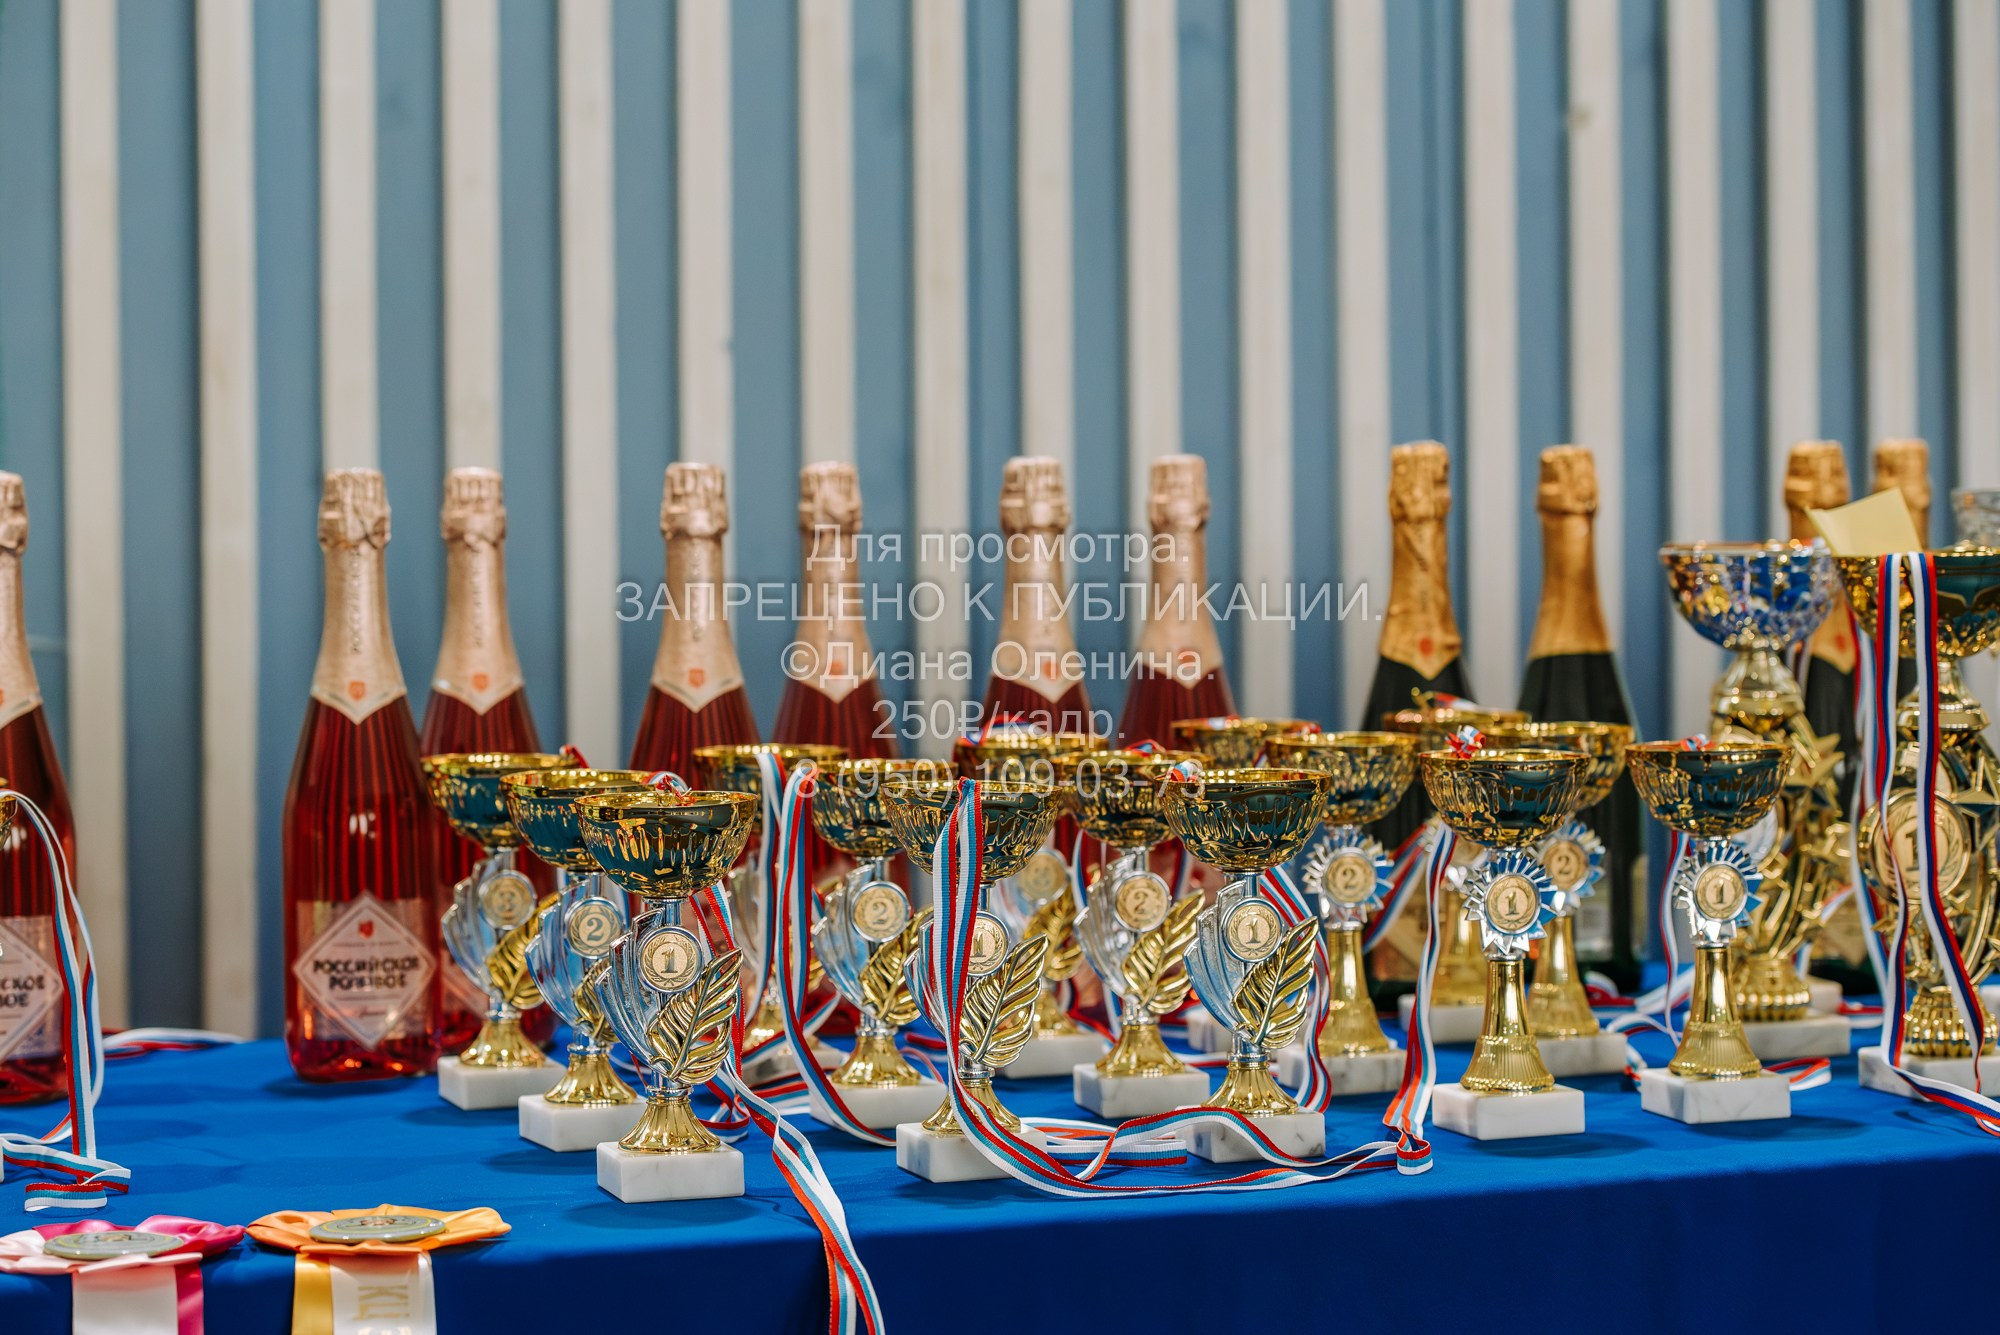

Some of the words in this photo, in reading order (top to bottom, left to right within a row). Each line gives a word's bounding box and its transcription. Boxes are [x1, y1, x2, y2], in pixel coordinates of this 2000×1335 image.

[1905, 829, 1919, 872] 1
[1342, 867, 1358, 890] 2
[1558, 855, 1573, 877] 2
[1715, 878, 1727, 904] 1
[870, 902, 889, 925] 2
[1134, 893, 1149, 916] 2
[1506, 892, 1520, 917] 1
[586, 918, 605, 942] 2
[1246, 919, 1261, 944] 1
[970, 932, 987, 958] 1
[661, 949, 679, 974] 1
